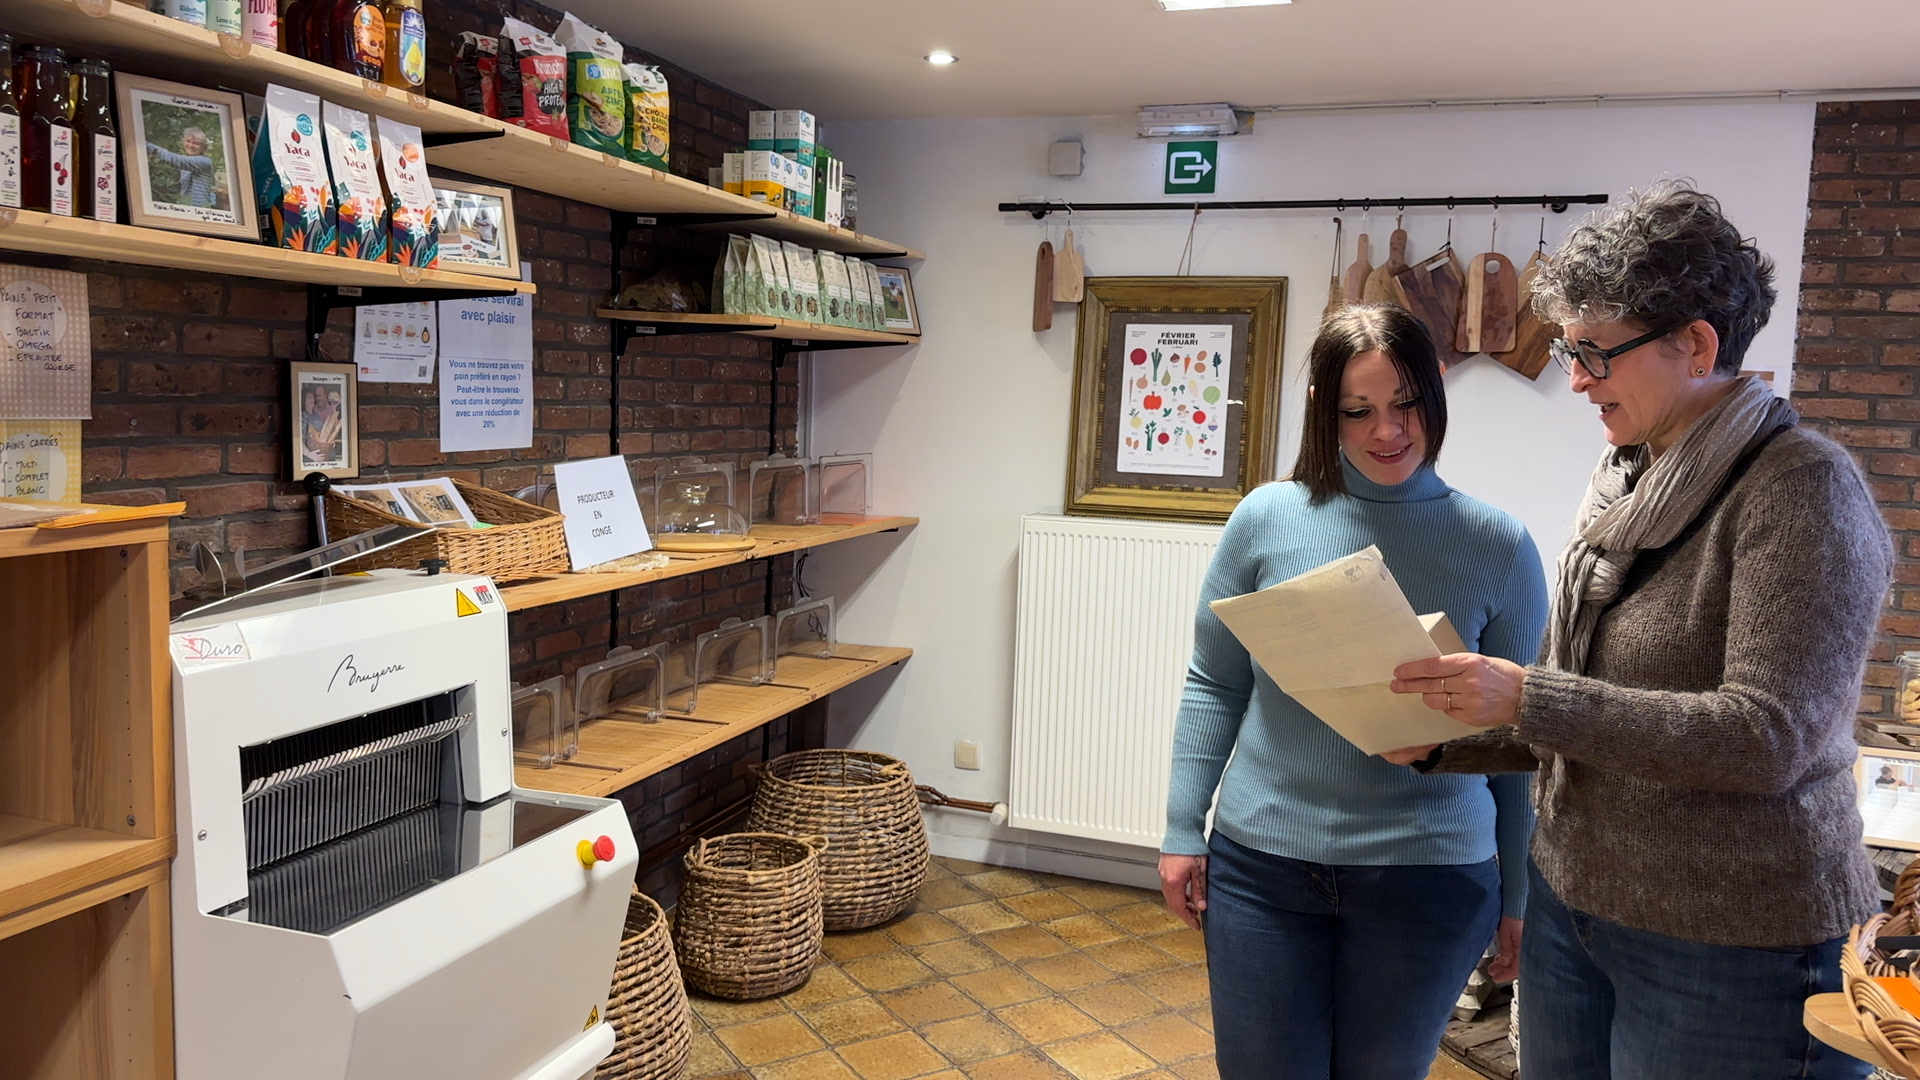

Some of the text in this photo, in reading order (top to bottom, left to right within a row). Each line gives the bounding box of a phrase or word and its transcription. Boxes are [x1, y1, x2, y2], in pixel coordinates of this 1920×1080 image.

[543, 82, 559, 95] HIGH
[284, 142, 311, 157] Yaca
[491, 295, 524, 306] servirai
[461, 310, 516, 325] avec plaisir
[1160, 331, 1196, 339] FÉVRIER
[17, 339, 52, 350] OMEGA
[1157, 338, 1198, 346] FEBRUARI
[449, 359, 467, 368] Vous
[477, 361, 498, 369] trouvez
[499, 363, 510, 371] pas
[454, 373, 469, 381] pain
[470, 372, 491, 381] préféré
[500, 374, 517, 382] rayon
[457, 385, 485, 393] Peut-être
[486, 385, 491, 393] le
[468, 397, 483, 405] dans
[485, 397, 490, 405] le
[491, 397, 524, 406] congélateur
[485, 408, 512, 416] réduction
[482, 420, 495, 428] 20%
[15, 472, 49, 482] COMPLET
[15, 485, 46, 495] BLANC
[577, 489, 615, 504] PRODUCTEUR
[593, 510, 602, 519] EN
[592, 525, 612, 538] CONGE
[199, 638, 243, 660] Duro
